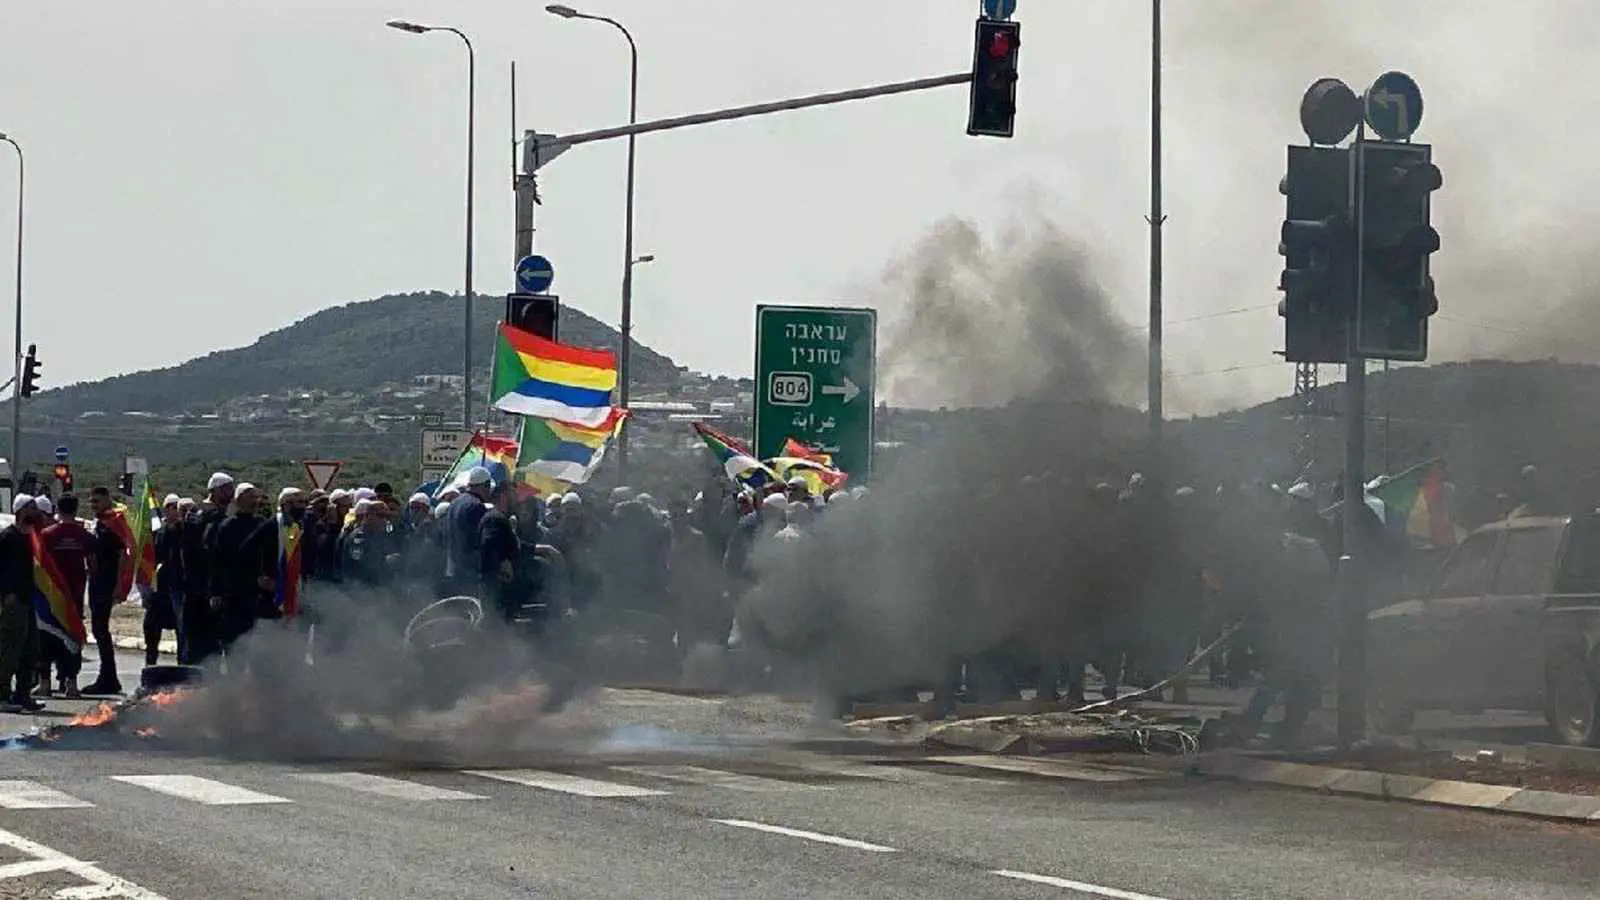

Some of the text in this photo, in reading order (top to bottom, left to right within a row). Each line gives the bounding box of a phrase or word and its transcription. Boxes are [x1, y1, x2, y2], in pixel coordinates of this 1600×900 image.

[785, 322, 848, 341] עראבה
[791, 347, 841, 365] סחנין
[775, 381, 809, 396] 804
